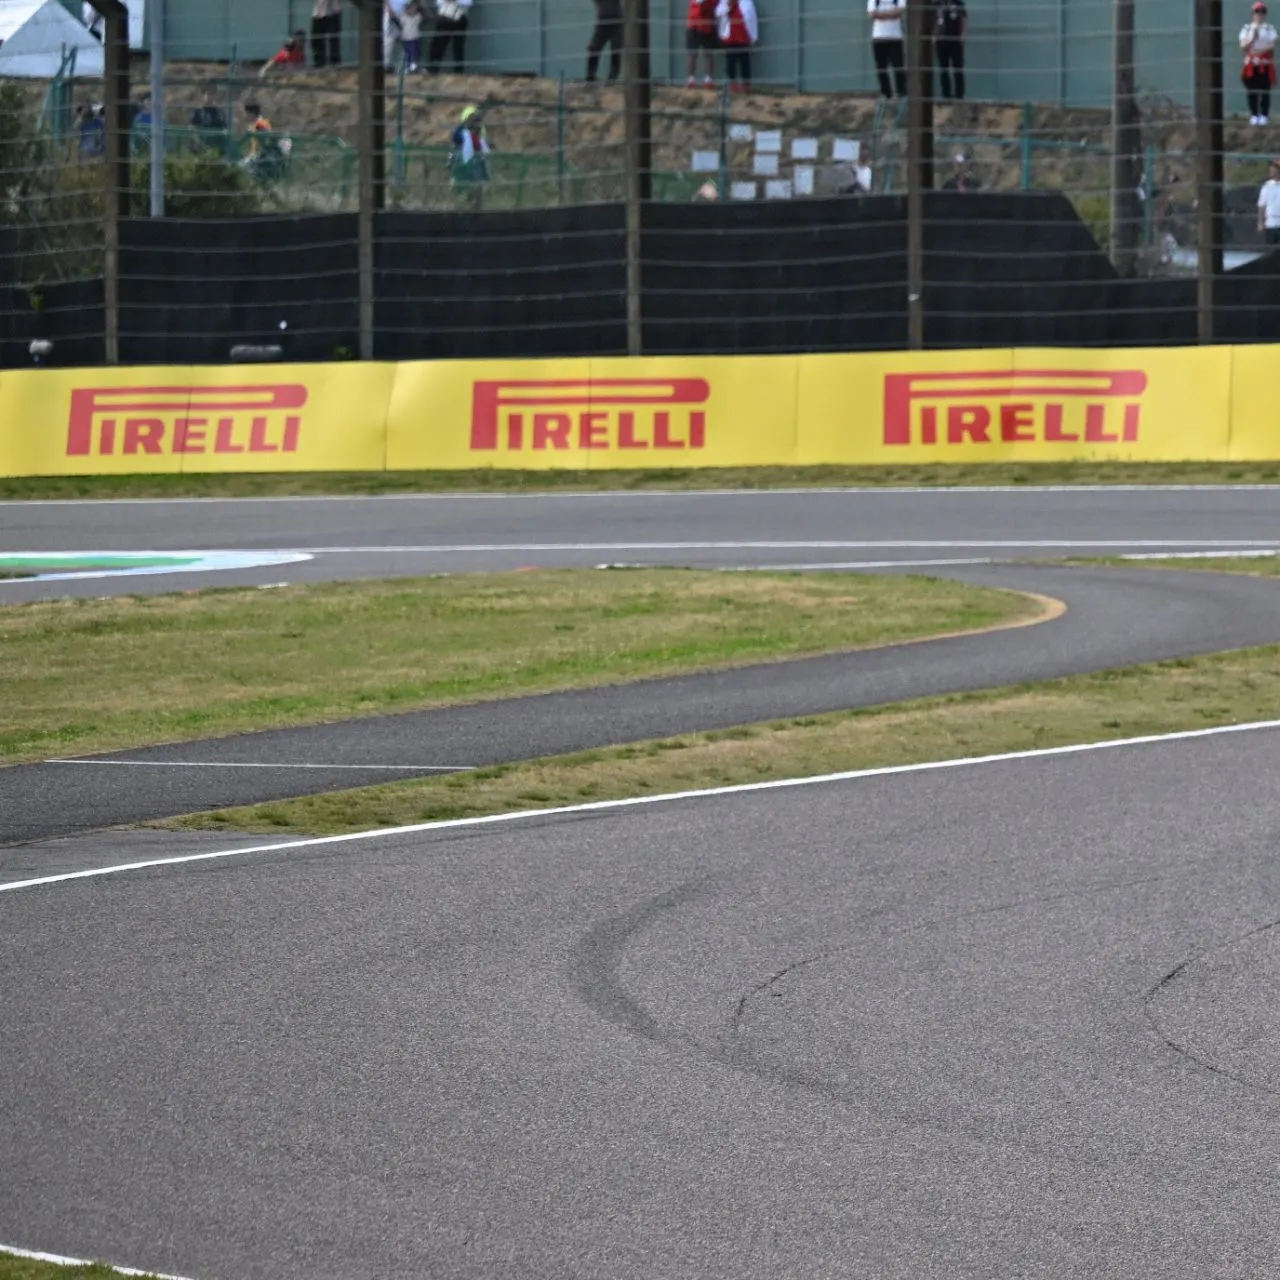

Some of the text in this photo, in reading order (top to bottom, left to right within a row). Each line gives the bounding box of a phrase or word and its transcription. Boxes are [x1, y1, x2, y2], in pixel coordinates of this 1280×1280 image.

[67, 384, 308, 455] PIRELLI
[471, 378, 710, 450] PIRELLI
[884, 369, 1148, 445] PIRELLI
